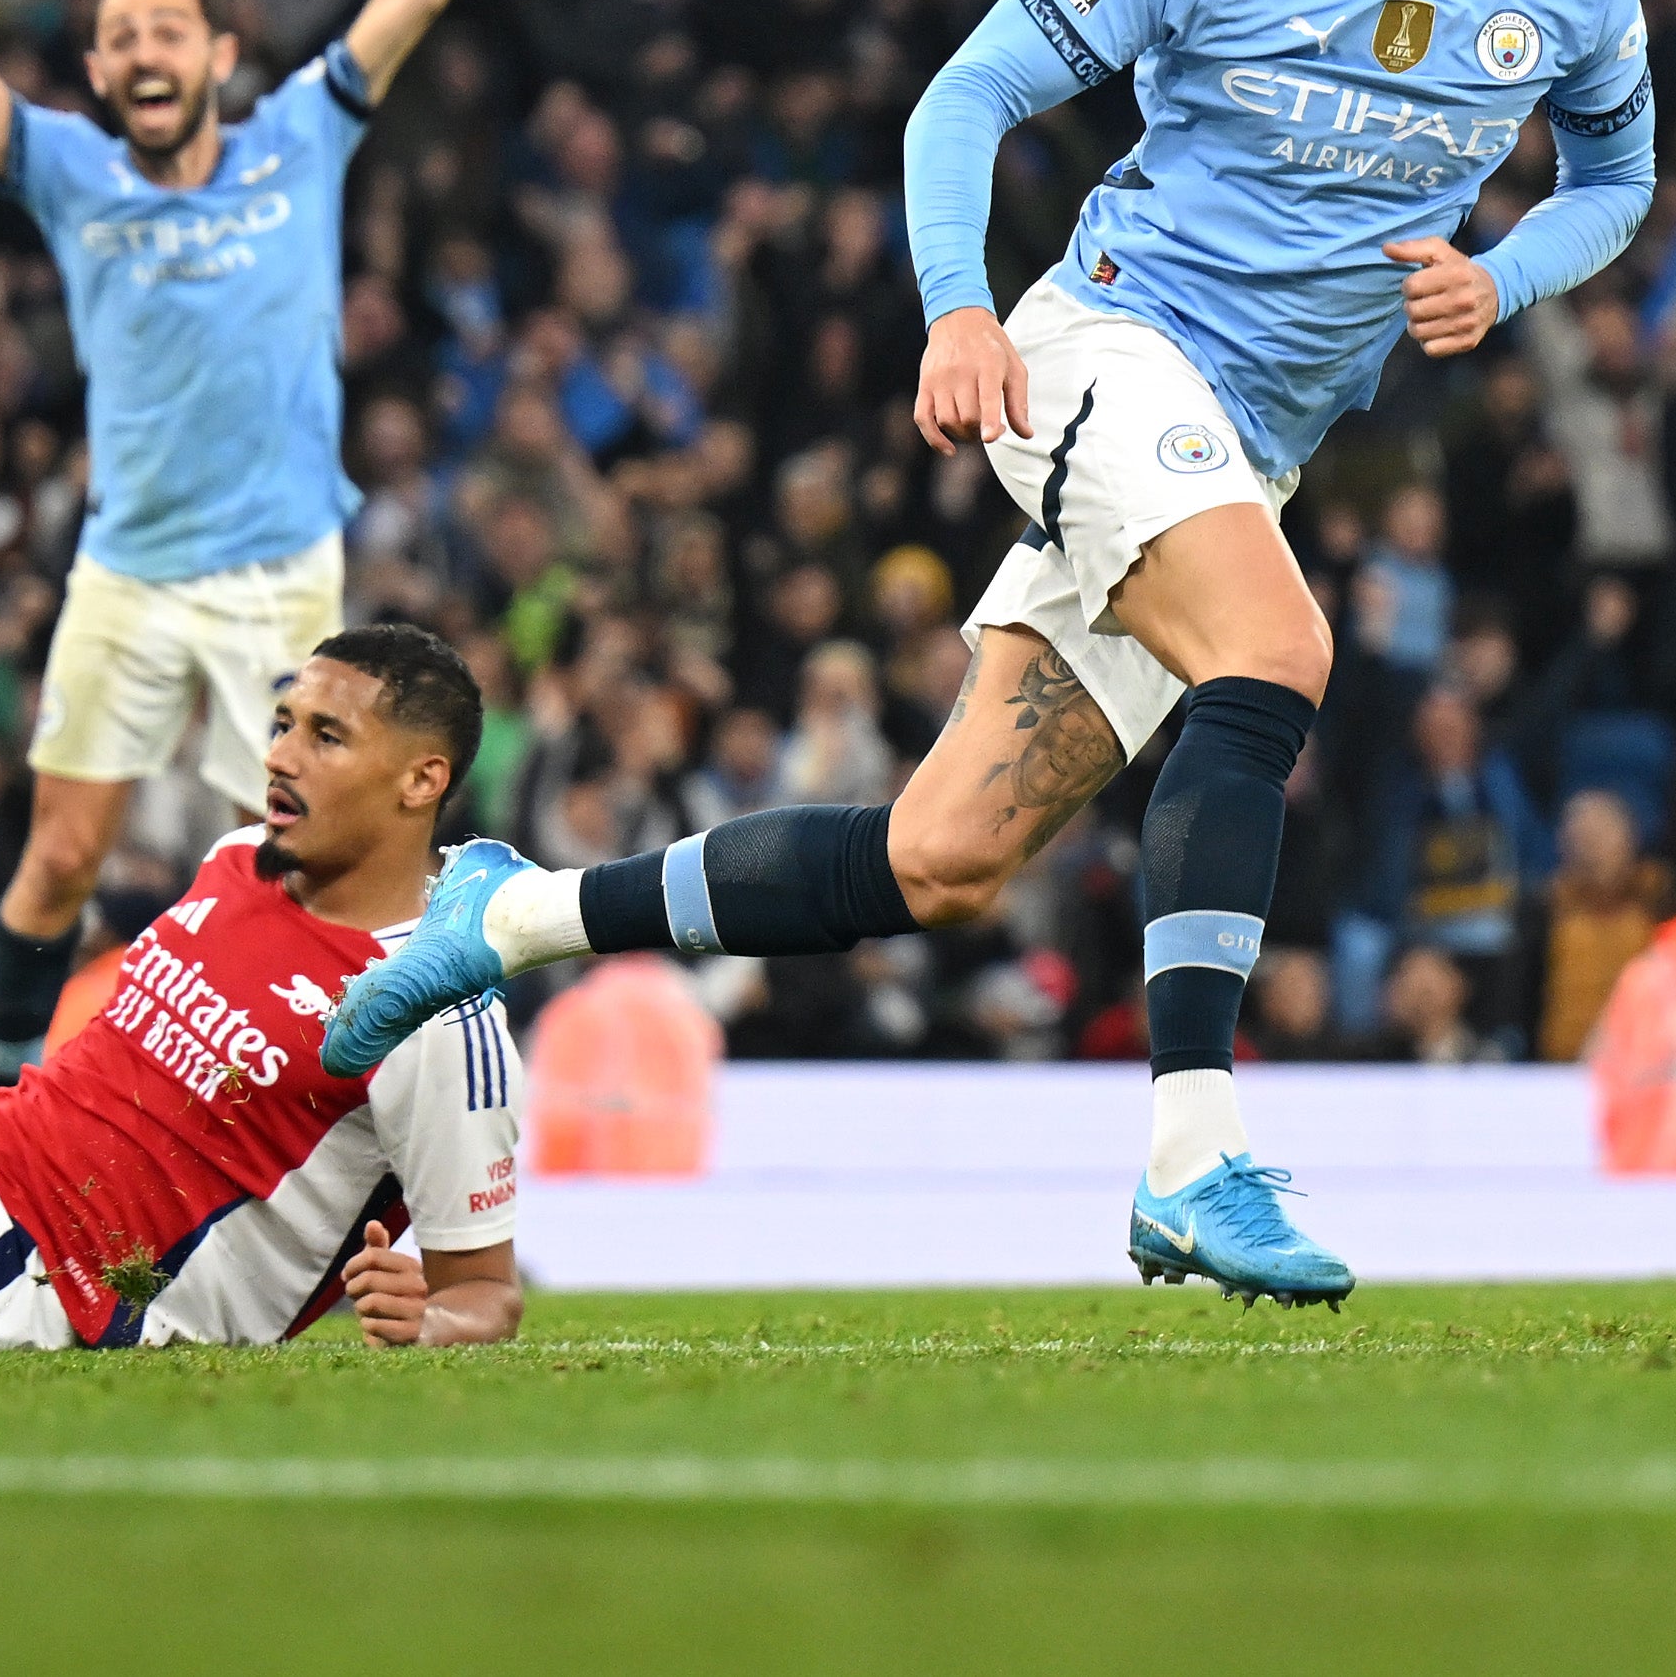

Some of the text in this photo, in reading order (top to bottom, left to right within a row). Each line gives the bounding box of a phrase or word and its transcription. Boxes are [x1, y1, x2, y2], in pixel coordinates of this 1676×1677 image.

[1386, 45, 1411, 58] FIFA
[1482, 15, 1535, 39] MANCHESTER
[1498, 70, 1518, 78] CITY
[1221, 67, 1520, 157] ETIHAD
[1271, 136, 1445, 188] AIRWAYS
[121, 926, 290, 1087] Emirates
[141, 1009, 230, 1103] BETTER
